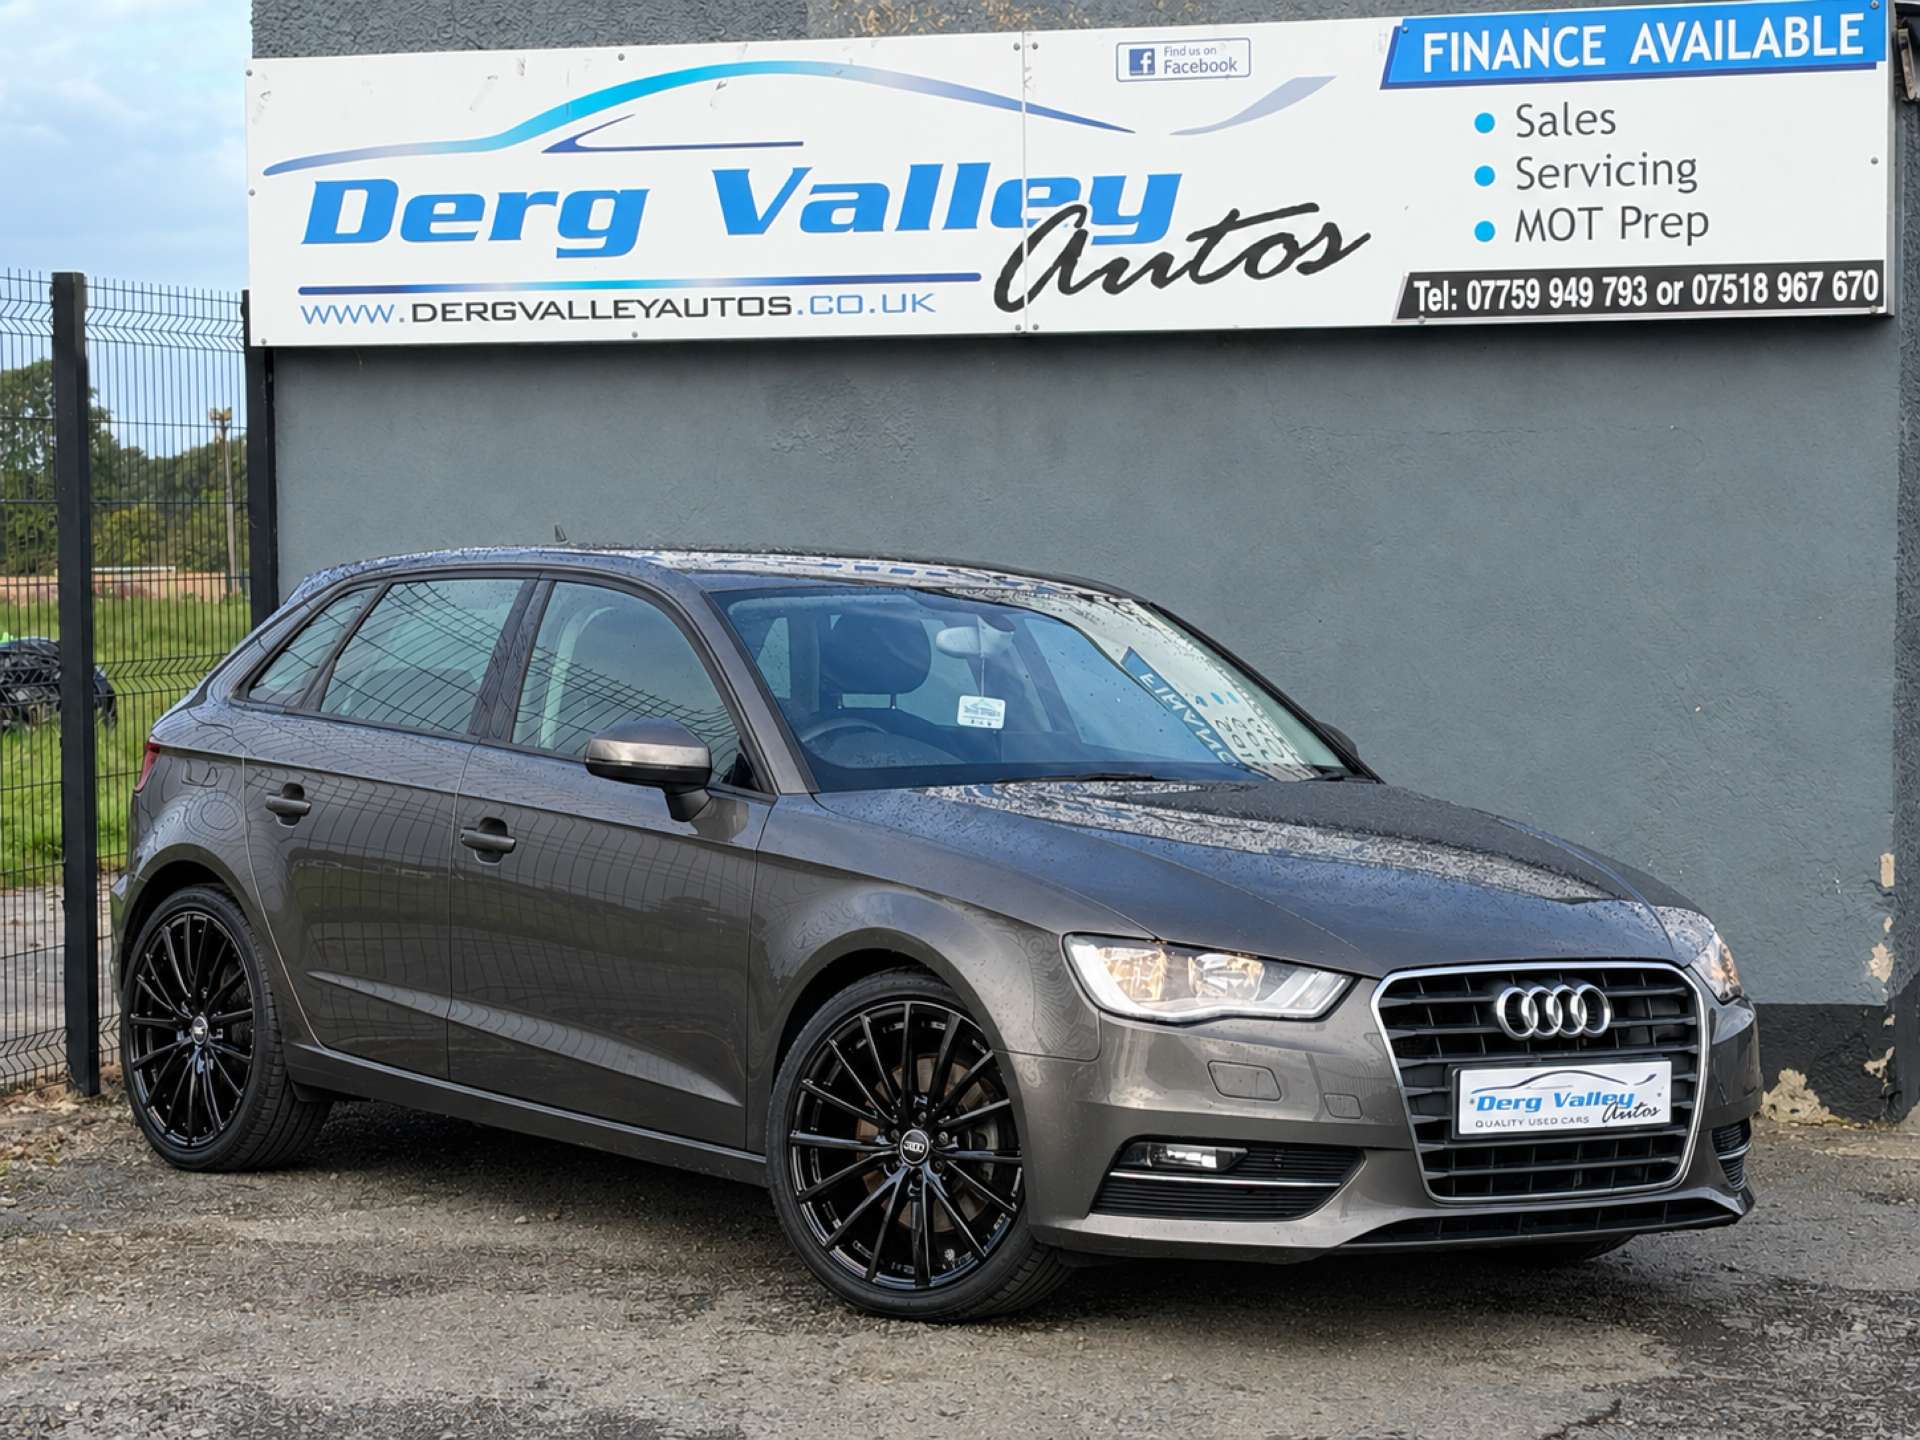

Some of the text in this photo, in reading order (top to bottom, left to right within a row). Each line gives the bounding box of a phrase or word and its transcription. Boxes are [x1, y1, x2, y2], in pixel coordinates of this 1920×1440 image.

[1163, 46, 1217, 57] Find us on
[1423, 13, 1865, 73] FINANCE AVAILABLE
[1163, 57, 1239, 75] Facebook
[1515, 102, 1617, 138] Sales
[1515, 152, 1699, 194] Servicing
[301, 161, 1183, 259] Derg Valley
[1514, 205, 1710, 246] MOT Prep
[994, 202, 1371, 313] Autos
[1413, 268, 1880, 312] Tel: 07759 949 793 or 07518 967 670
[1475, 1115, 1590, 1129] QUALITY USED CARS
[1476, 1091, 1636, 1113] Derg Valley
